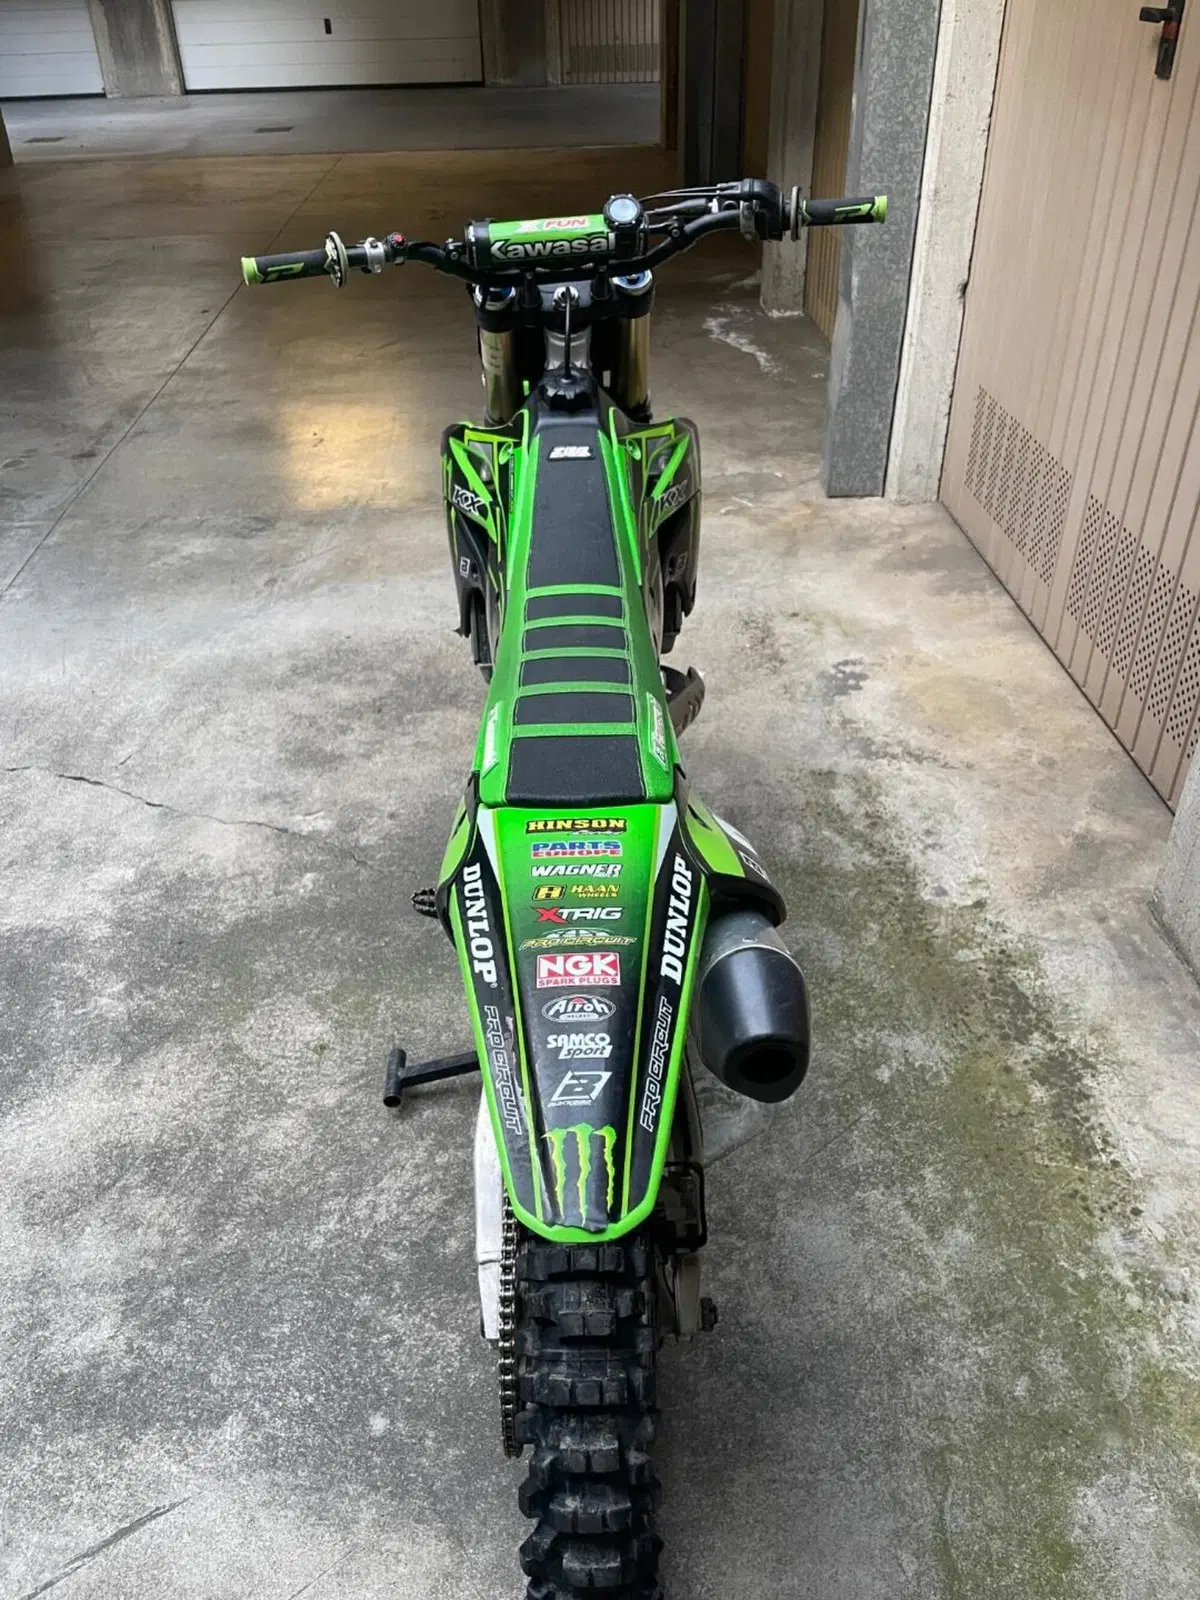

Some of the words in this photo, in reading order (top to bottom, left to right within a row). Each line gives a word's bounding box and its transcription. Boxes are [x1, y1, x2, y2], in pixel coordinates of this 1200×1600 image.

[527, 819, 626, 831] HINSON
[532, 841, 621, 851] PARTS
[532, 864, 622, 877] WAGNER
[571, 885, 619, 894] HAAN
[463, 862, 497, 984] DUNLOP
[531, 907, 623, 924] XTRIG
[660, 855, 692, 986] DUNLOP
[540, 954, 617, 977] NGK
[538, 978, 576, 987] SPARK
[579, 976, 618, 985] PLUGS
[548, 998, 609, 1016] Airoh
[484, 1005, 504, 1050] PRO
[546, 1032, 611, 1048] SAMCO
[649, 996, 673, 1081] CIRCUIT
[565, 1045, 606, 1059] sport
[493, 1050, 522, 1136] CIRCUIT
[640, 1077, 662, 1132] PRO
